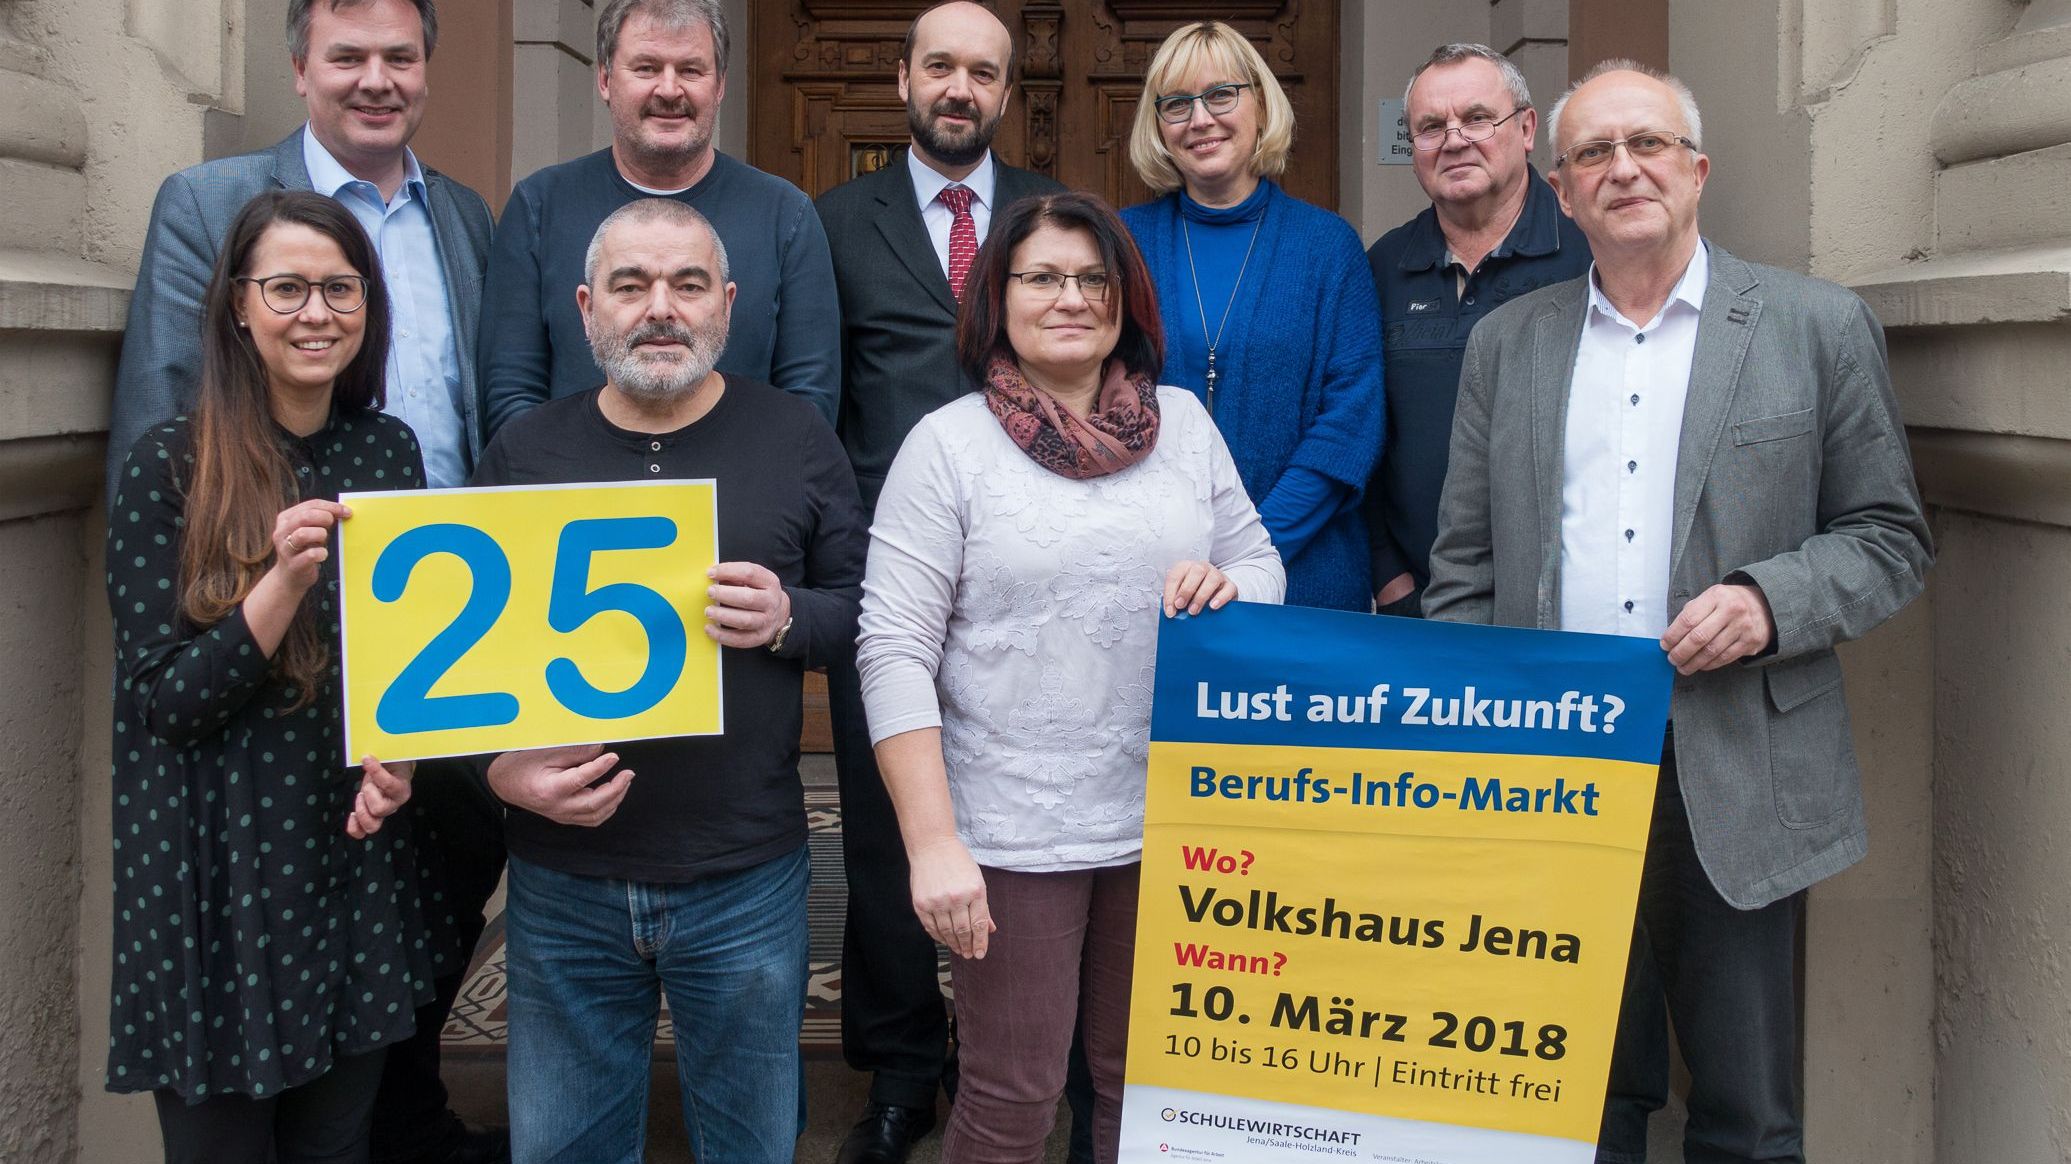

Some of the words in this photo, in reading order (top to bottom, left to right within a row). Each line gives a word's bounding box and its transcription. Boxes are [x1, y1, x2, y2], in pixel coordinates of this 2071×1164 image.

[1392, 145, 1413, 156] Eing
[372, 517, 687, 735] 25
[1197, 682, 1293, 722] Lust
[1306, 684, 1390, 724] auf
[1401, 686, 1625, 734] Zukunft?
[1190, 766, 1600, 816] Berufs-Info-Markt
[1182, 845, 1255, 876] Wo?
[1178, 885, 1446, 949] Volkshaus
[1460, 914, 1581, 964] Jena
[1173, 942, 1288, 977] Wann?
[1169, 982, 1251, 1024] 10.
[1269, 992, 1408, 1042] März
[1428, 1011, 1568, 1061] 2018
[1164, 1034, 1201, 1057] 10
[1211, 1037, 1252, 1064] bis
[1262, 1046, 1300, 1070] 16
[1309, 1052, 1366, 1079] Uhr
[1392, 1060, 1500, 1096] Eintritt
[1509, 1074, 1562, 1102] frei
[1179, 1110, 1361, 1146] SCHULEWIRTSCHAFT
[1246, 1135, 1358, 1157] Jena/Saale-Holzland-Kreis
